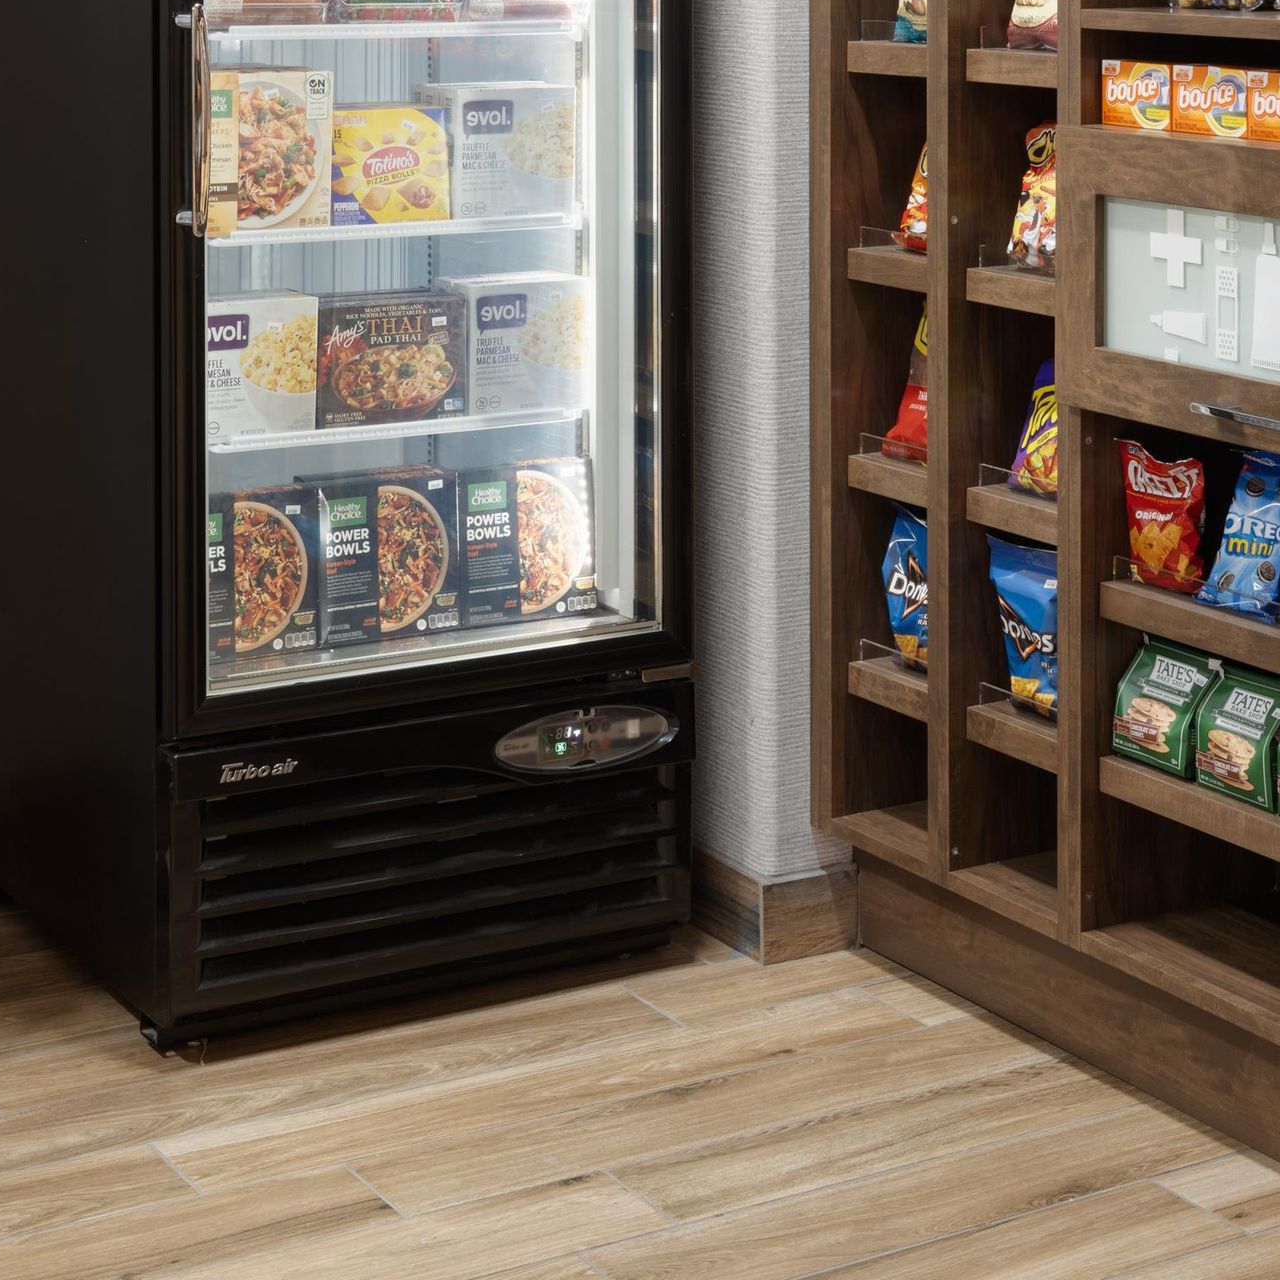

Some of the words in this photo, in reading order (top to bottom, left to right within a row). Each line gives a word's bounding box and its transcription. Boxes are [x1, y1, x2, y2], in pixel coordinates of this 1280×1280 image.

[1106, 76, 1160, 106] bounce
[1177, 83, 1237, 113] bounce
[366, 150, 415, 173] Totino's
[366, 175, 390, 186] PIZZA
[391, 171, 416, 182] ROLLS
[369, 316, 422, 336] THAI
[370, 335, 391, 345] PAD
[394, 332, 421, 343] THAI
[476, 347, 510, 357] PARMESAN
[474, 488, 501, 501] Healthy
[333, 503, 361, 516] Healthy
[466, 513, 509, 527] POWER
[326, 528, 369, 544] POWER
[466, 525, 512, 542] BOWLS
[326, 541, 371, 558] BOWLS
[1228, 536, 1274, 555] mini
[1157, 658, 1194, 683] TATE'S
[1234, 691, 1272, 715] TATE'S
[219, 762, 268, 784] Turbo
[272, 758, 298, 776] air
